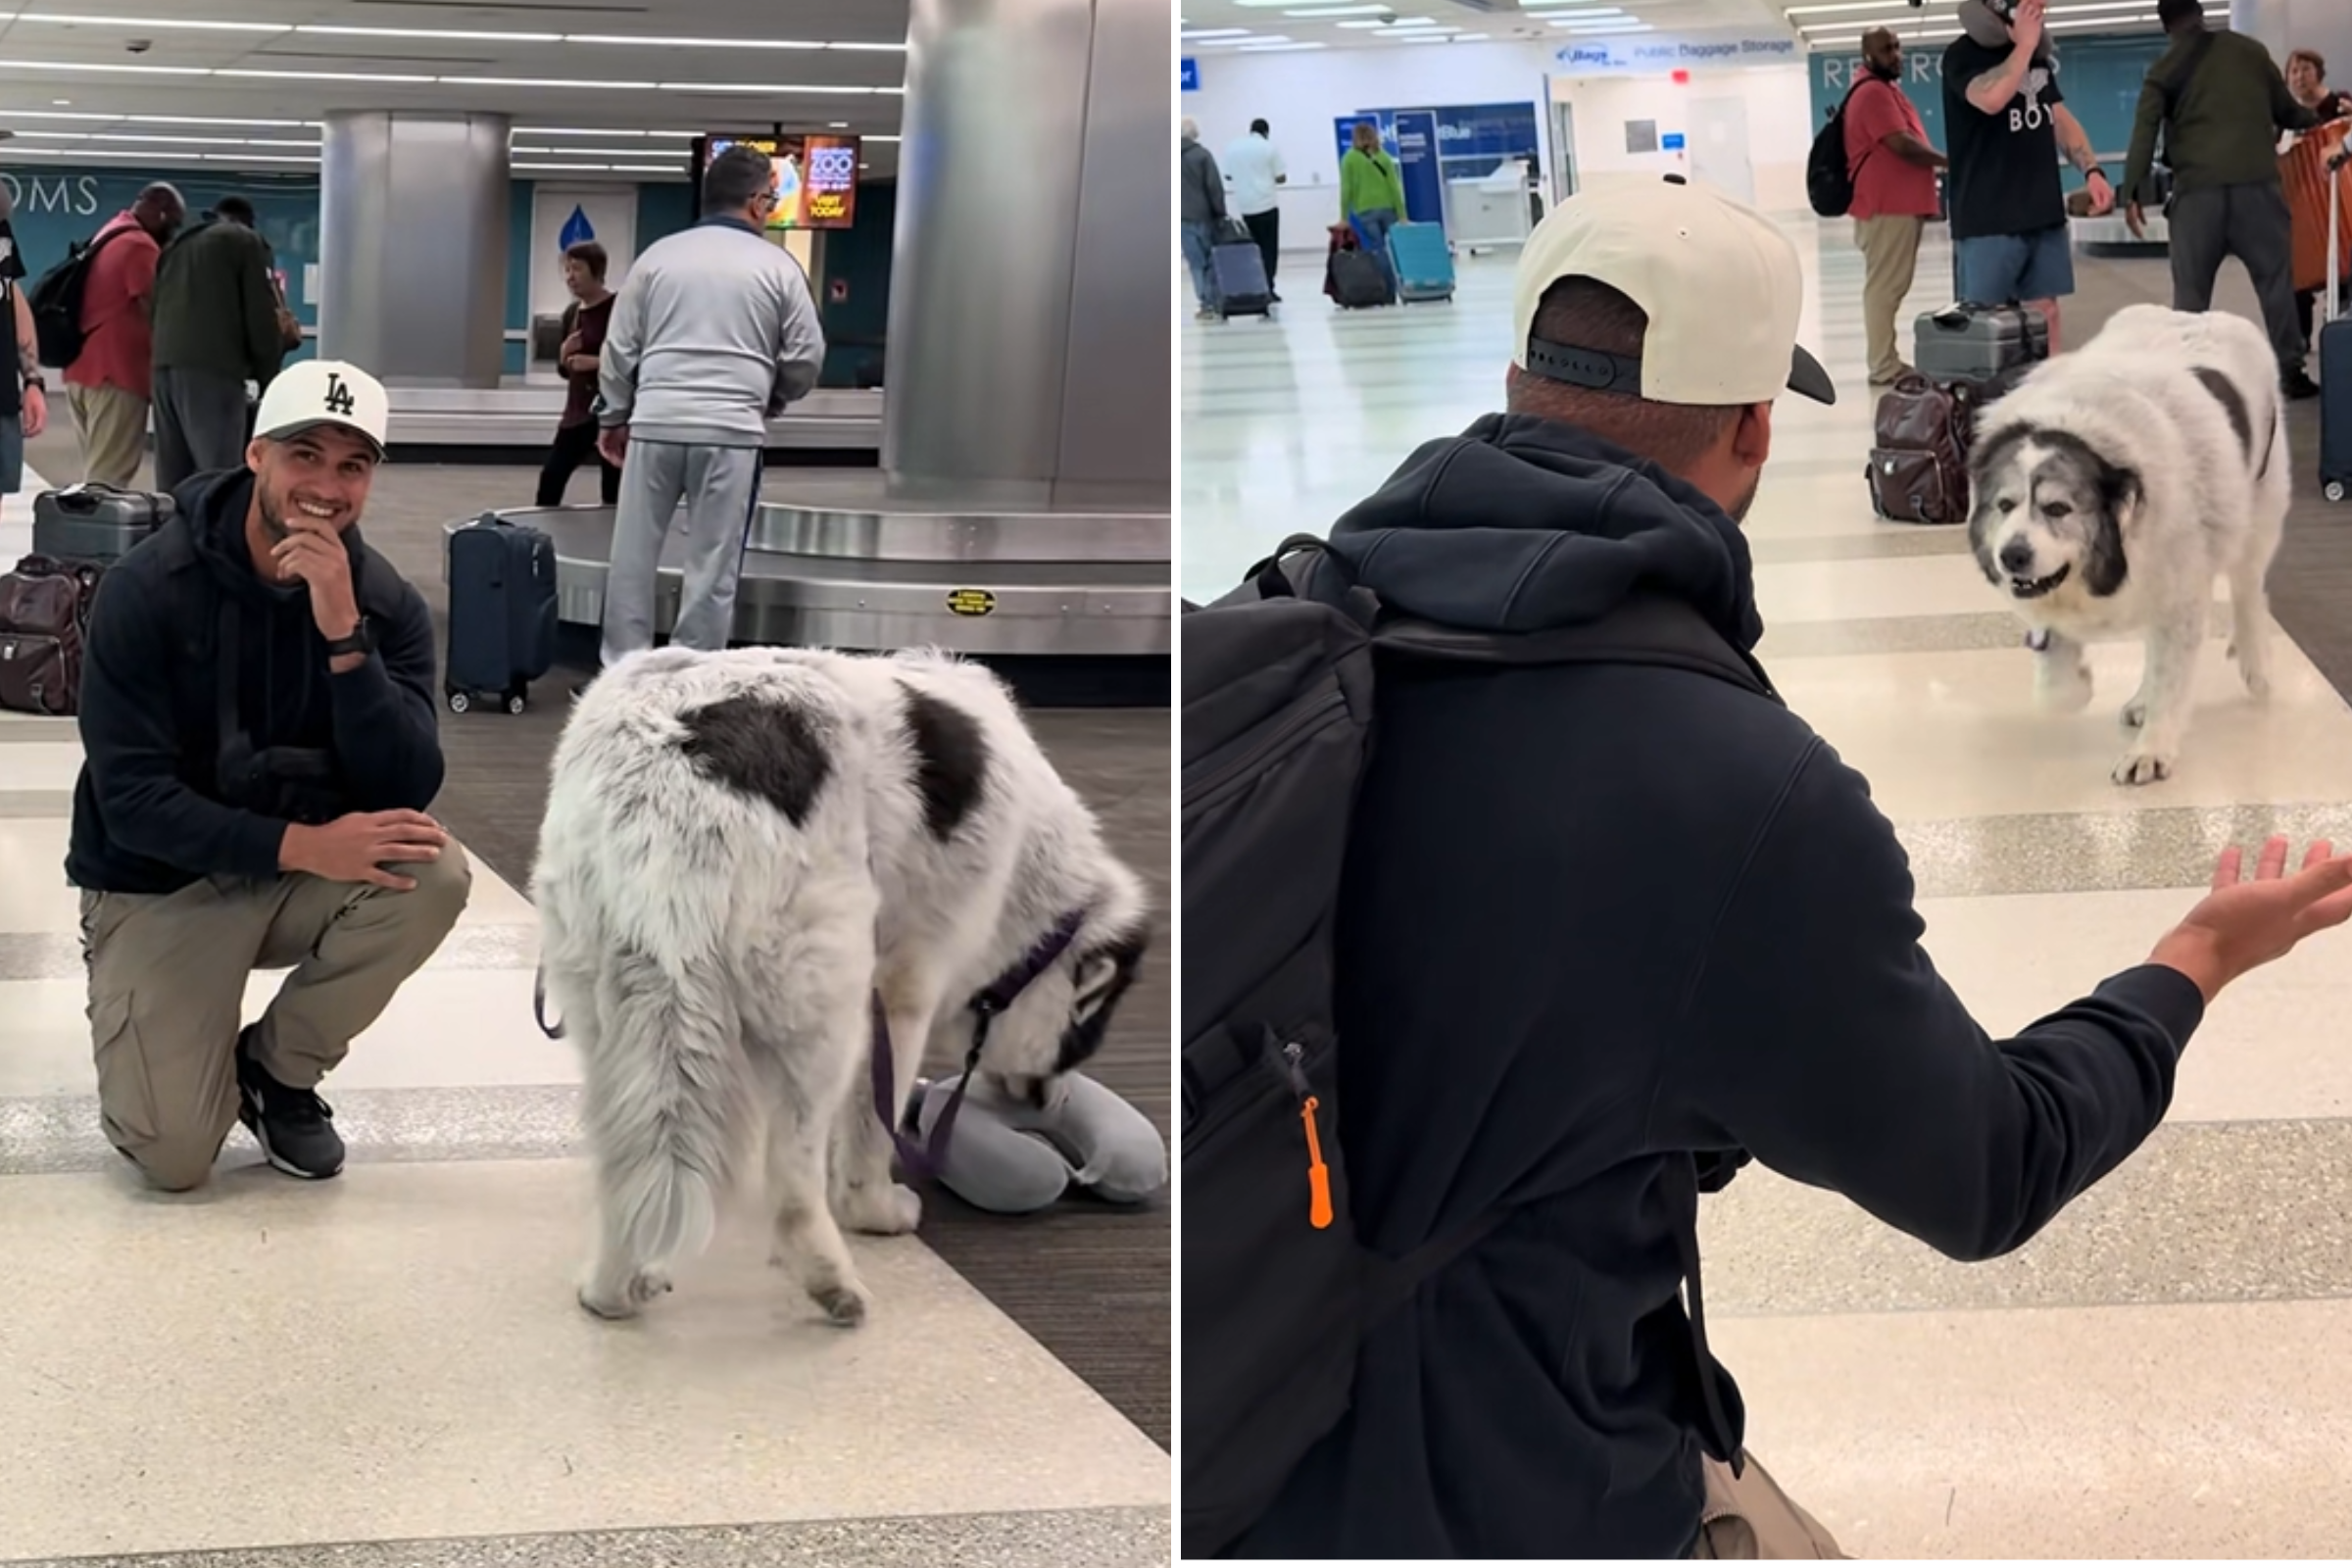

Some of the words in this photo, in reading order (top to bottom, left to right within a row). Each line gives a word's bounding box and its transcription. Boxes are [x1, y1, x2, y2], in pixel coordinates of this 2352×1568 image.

[1679, 43, 1739, 58] Baggage
[1740, 39, 1794, 54] Storage
[809, 155, 854, 174] ZOO
[323, 372, 355, 416] LA
